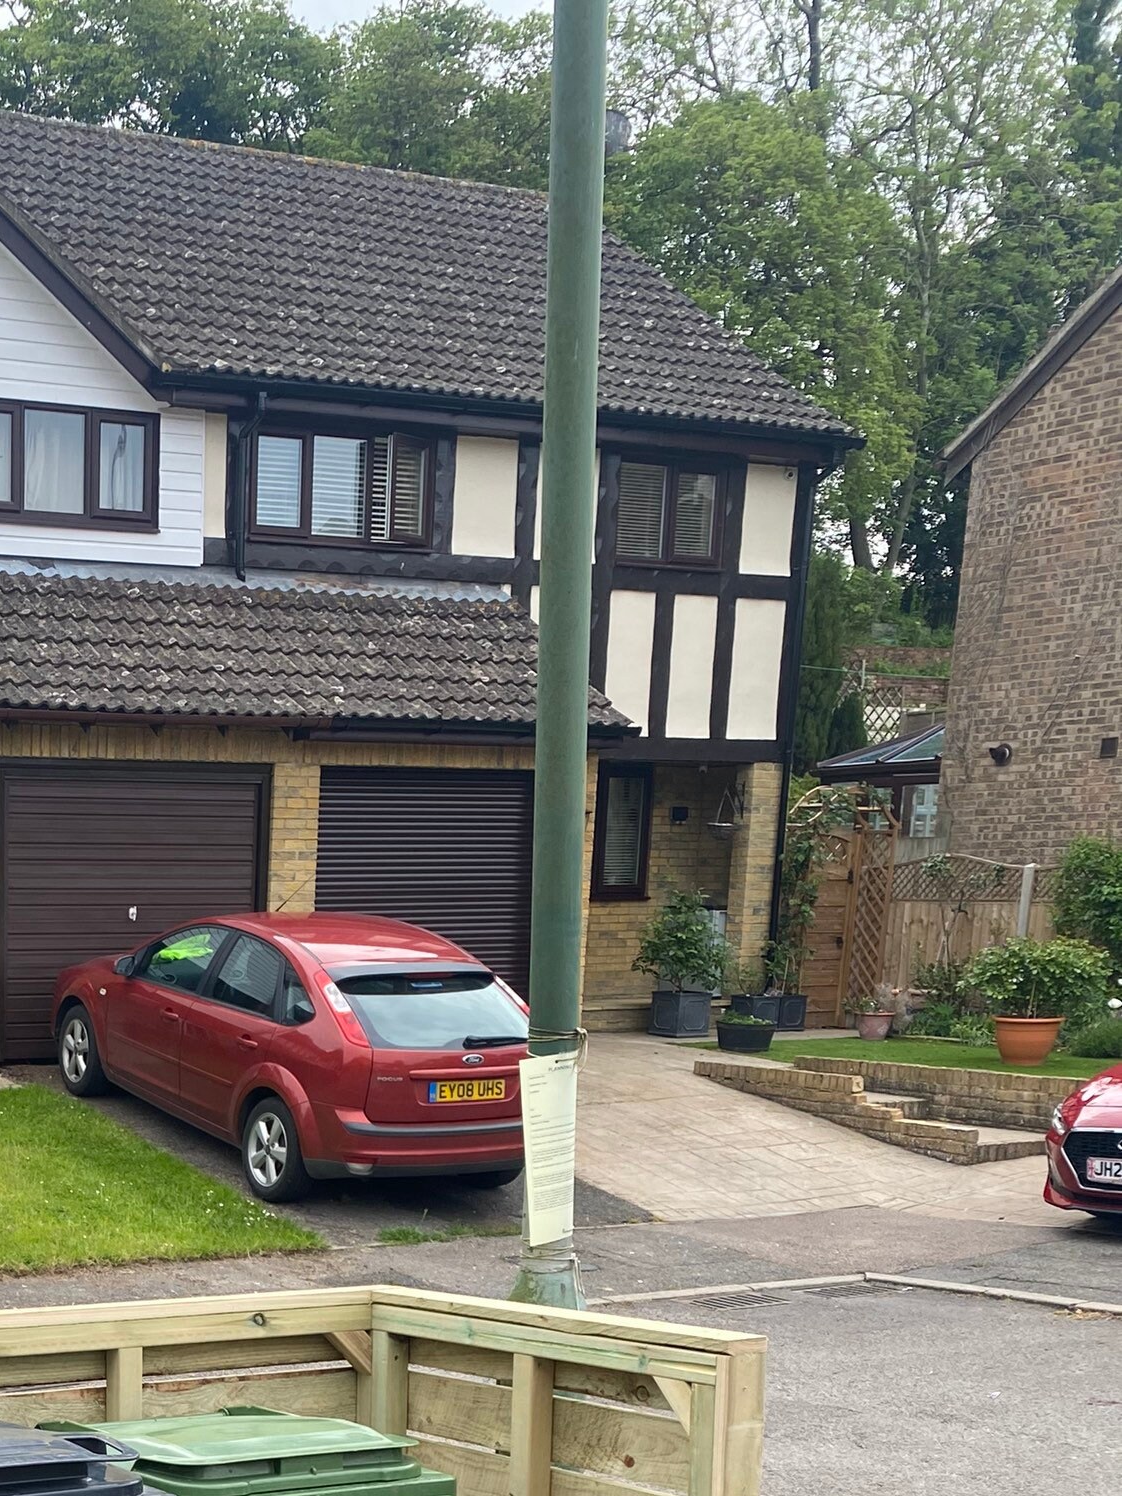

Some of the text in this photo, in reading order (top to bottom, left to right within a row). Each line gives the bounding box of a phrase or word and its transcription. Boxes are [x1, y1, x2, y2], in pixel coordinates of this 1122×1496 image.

[438, 1082, 474, 1099] EY08
[478, 1081, 503, 1097] UHS
[1094, 1161, 1122, 1177] JH2
